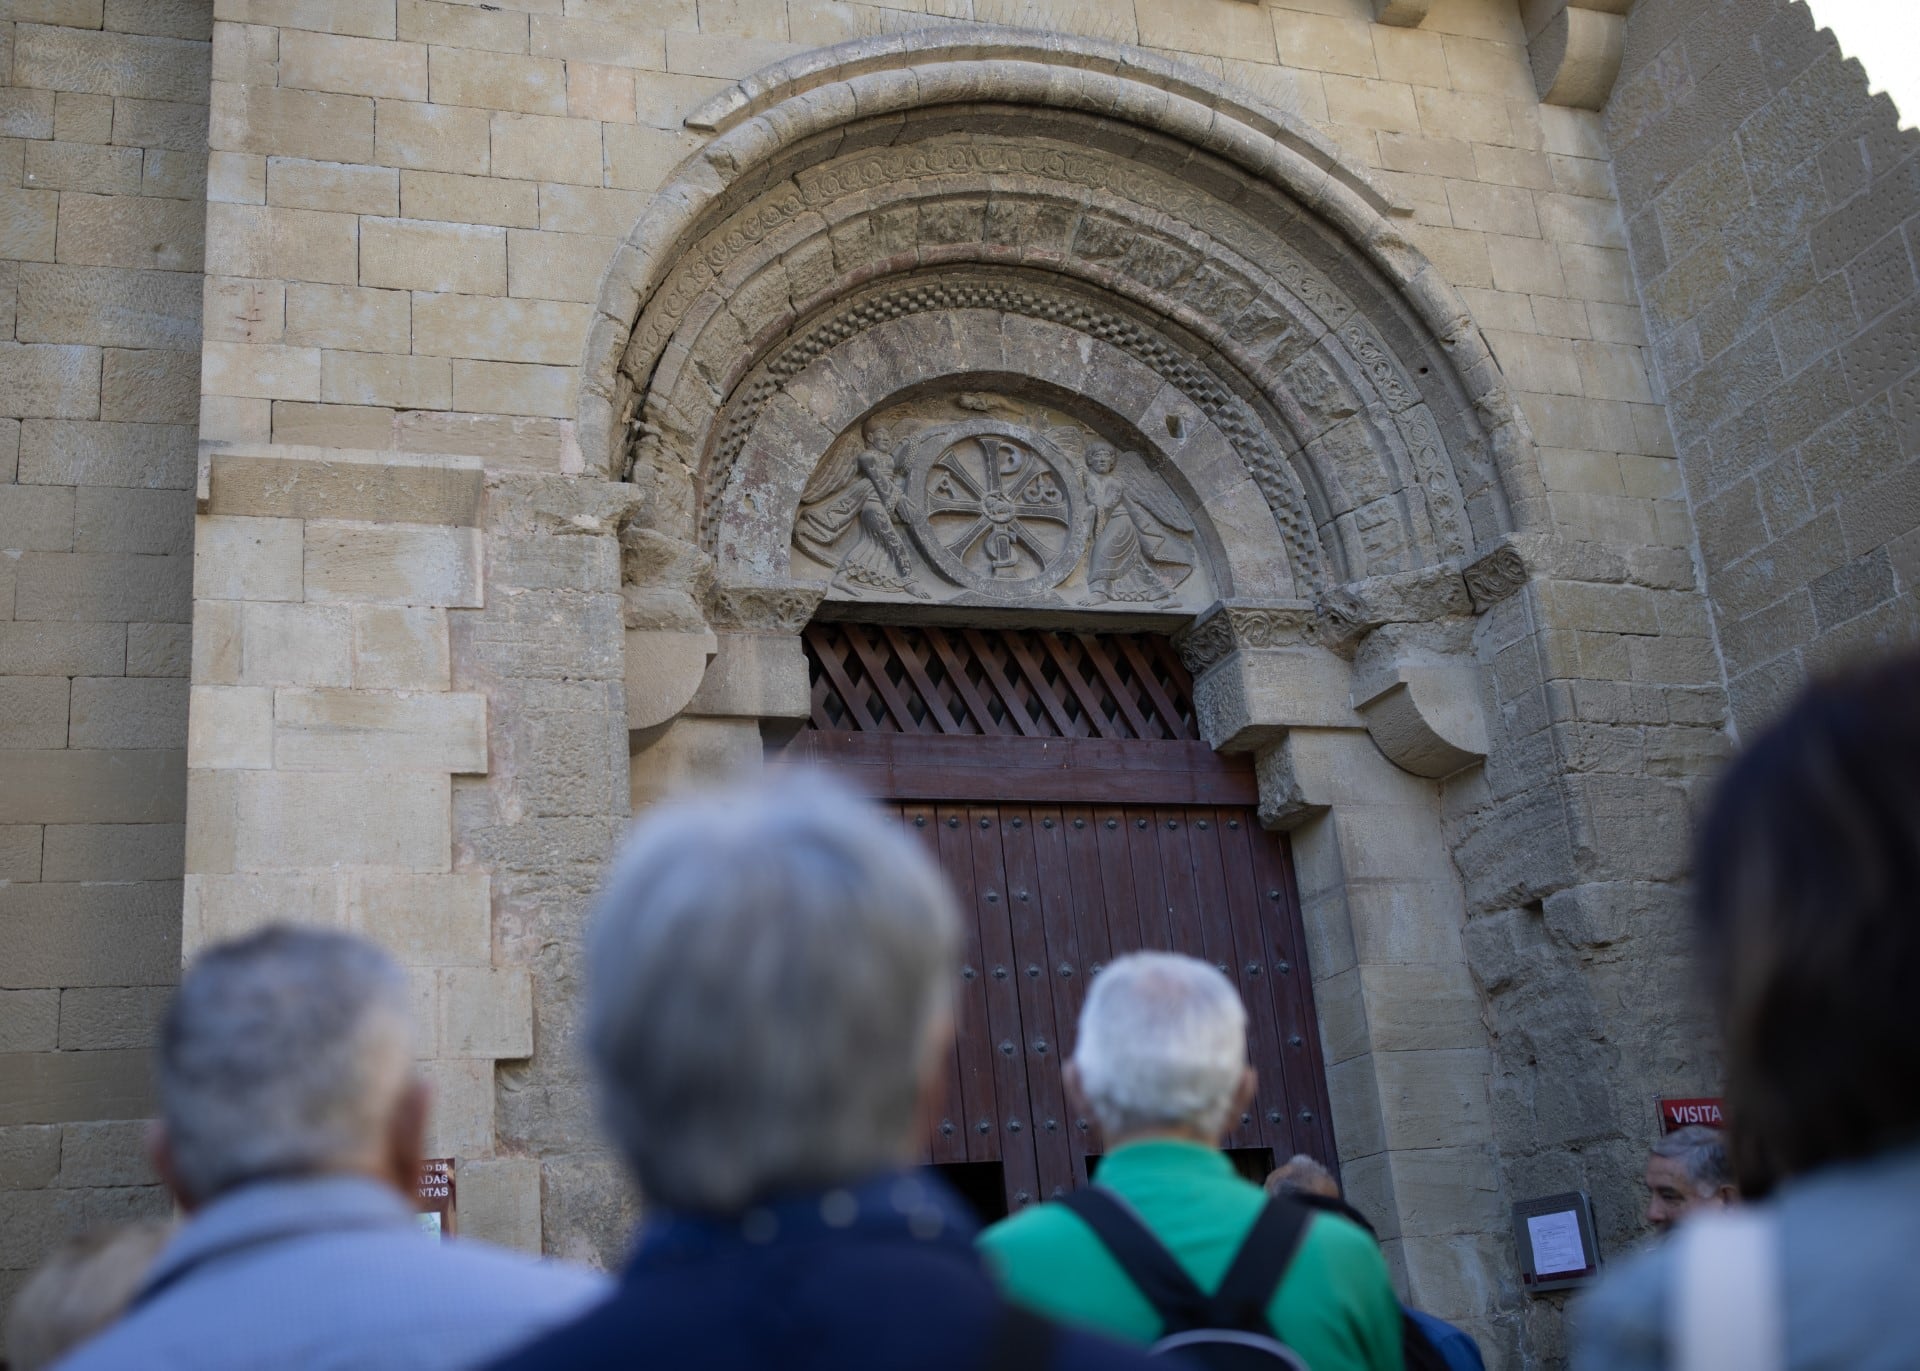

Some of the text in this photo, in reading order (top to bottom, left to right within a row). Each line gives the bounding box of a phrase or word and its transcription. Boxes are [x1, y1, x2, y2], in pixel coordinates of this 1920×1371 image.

[1671, 1105, 1722, 1123] VISITA
[435, 1163, 449, 1171] DE
[418, 1187, 449, 1197] NTAS
